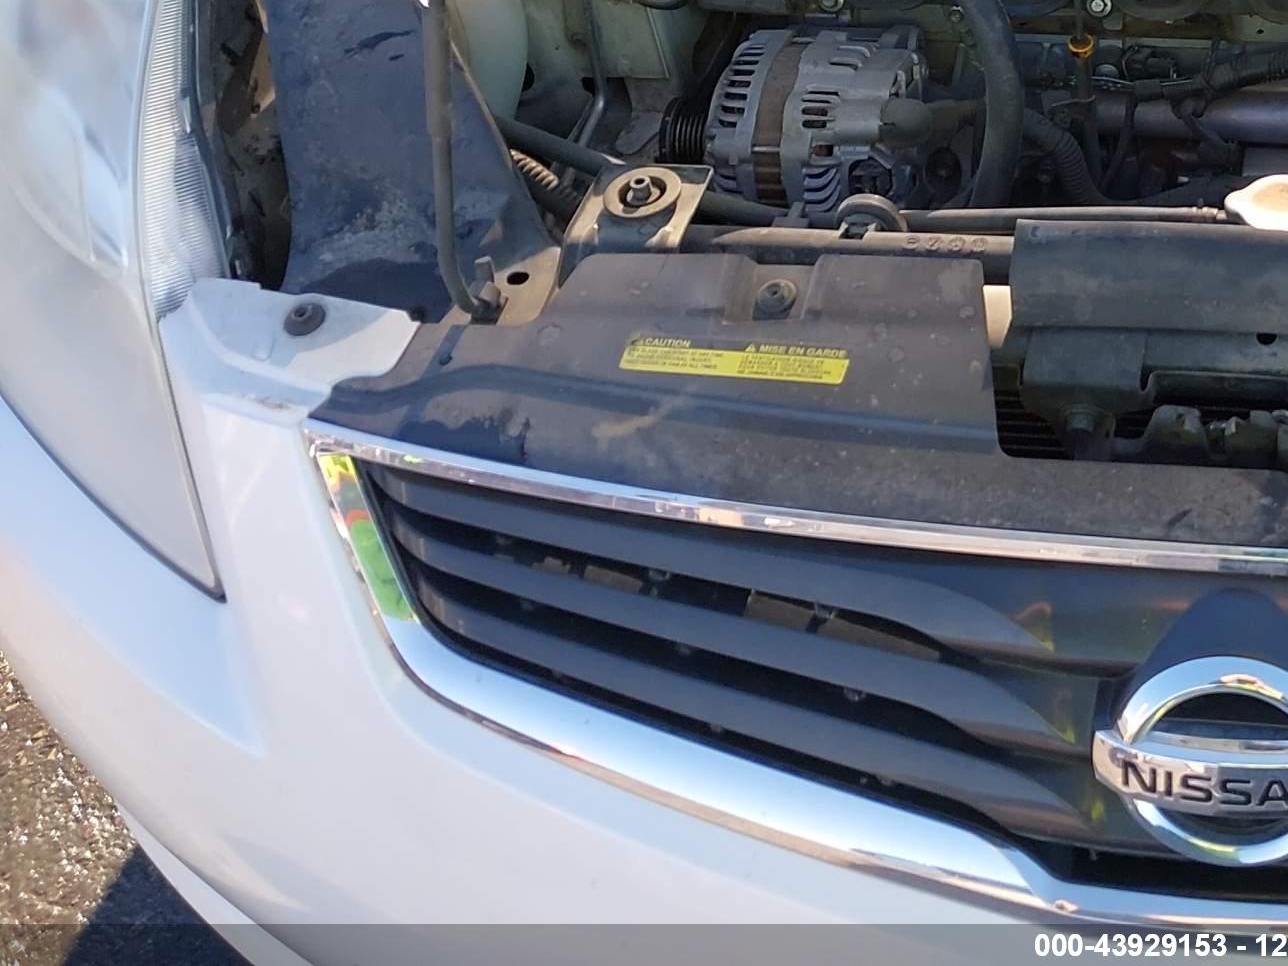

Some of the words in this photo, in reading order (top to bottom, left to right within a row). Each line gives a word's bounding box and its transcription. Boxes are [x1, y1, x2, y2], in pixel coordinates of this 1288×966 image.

[645, 337, 691, 347] CAUTION
[759, 344, 788, 354] MISE
[788, 345, 806, 355] EN
[806, 347, 847, 358] GARDE
